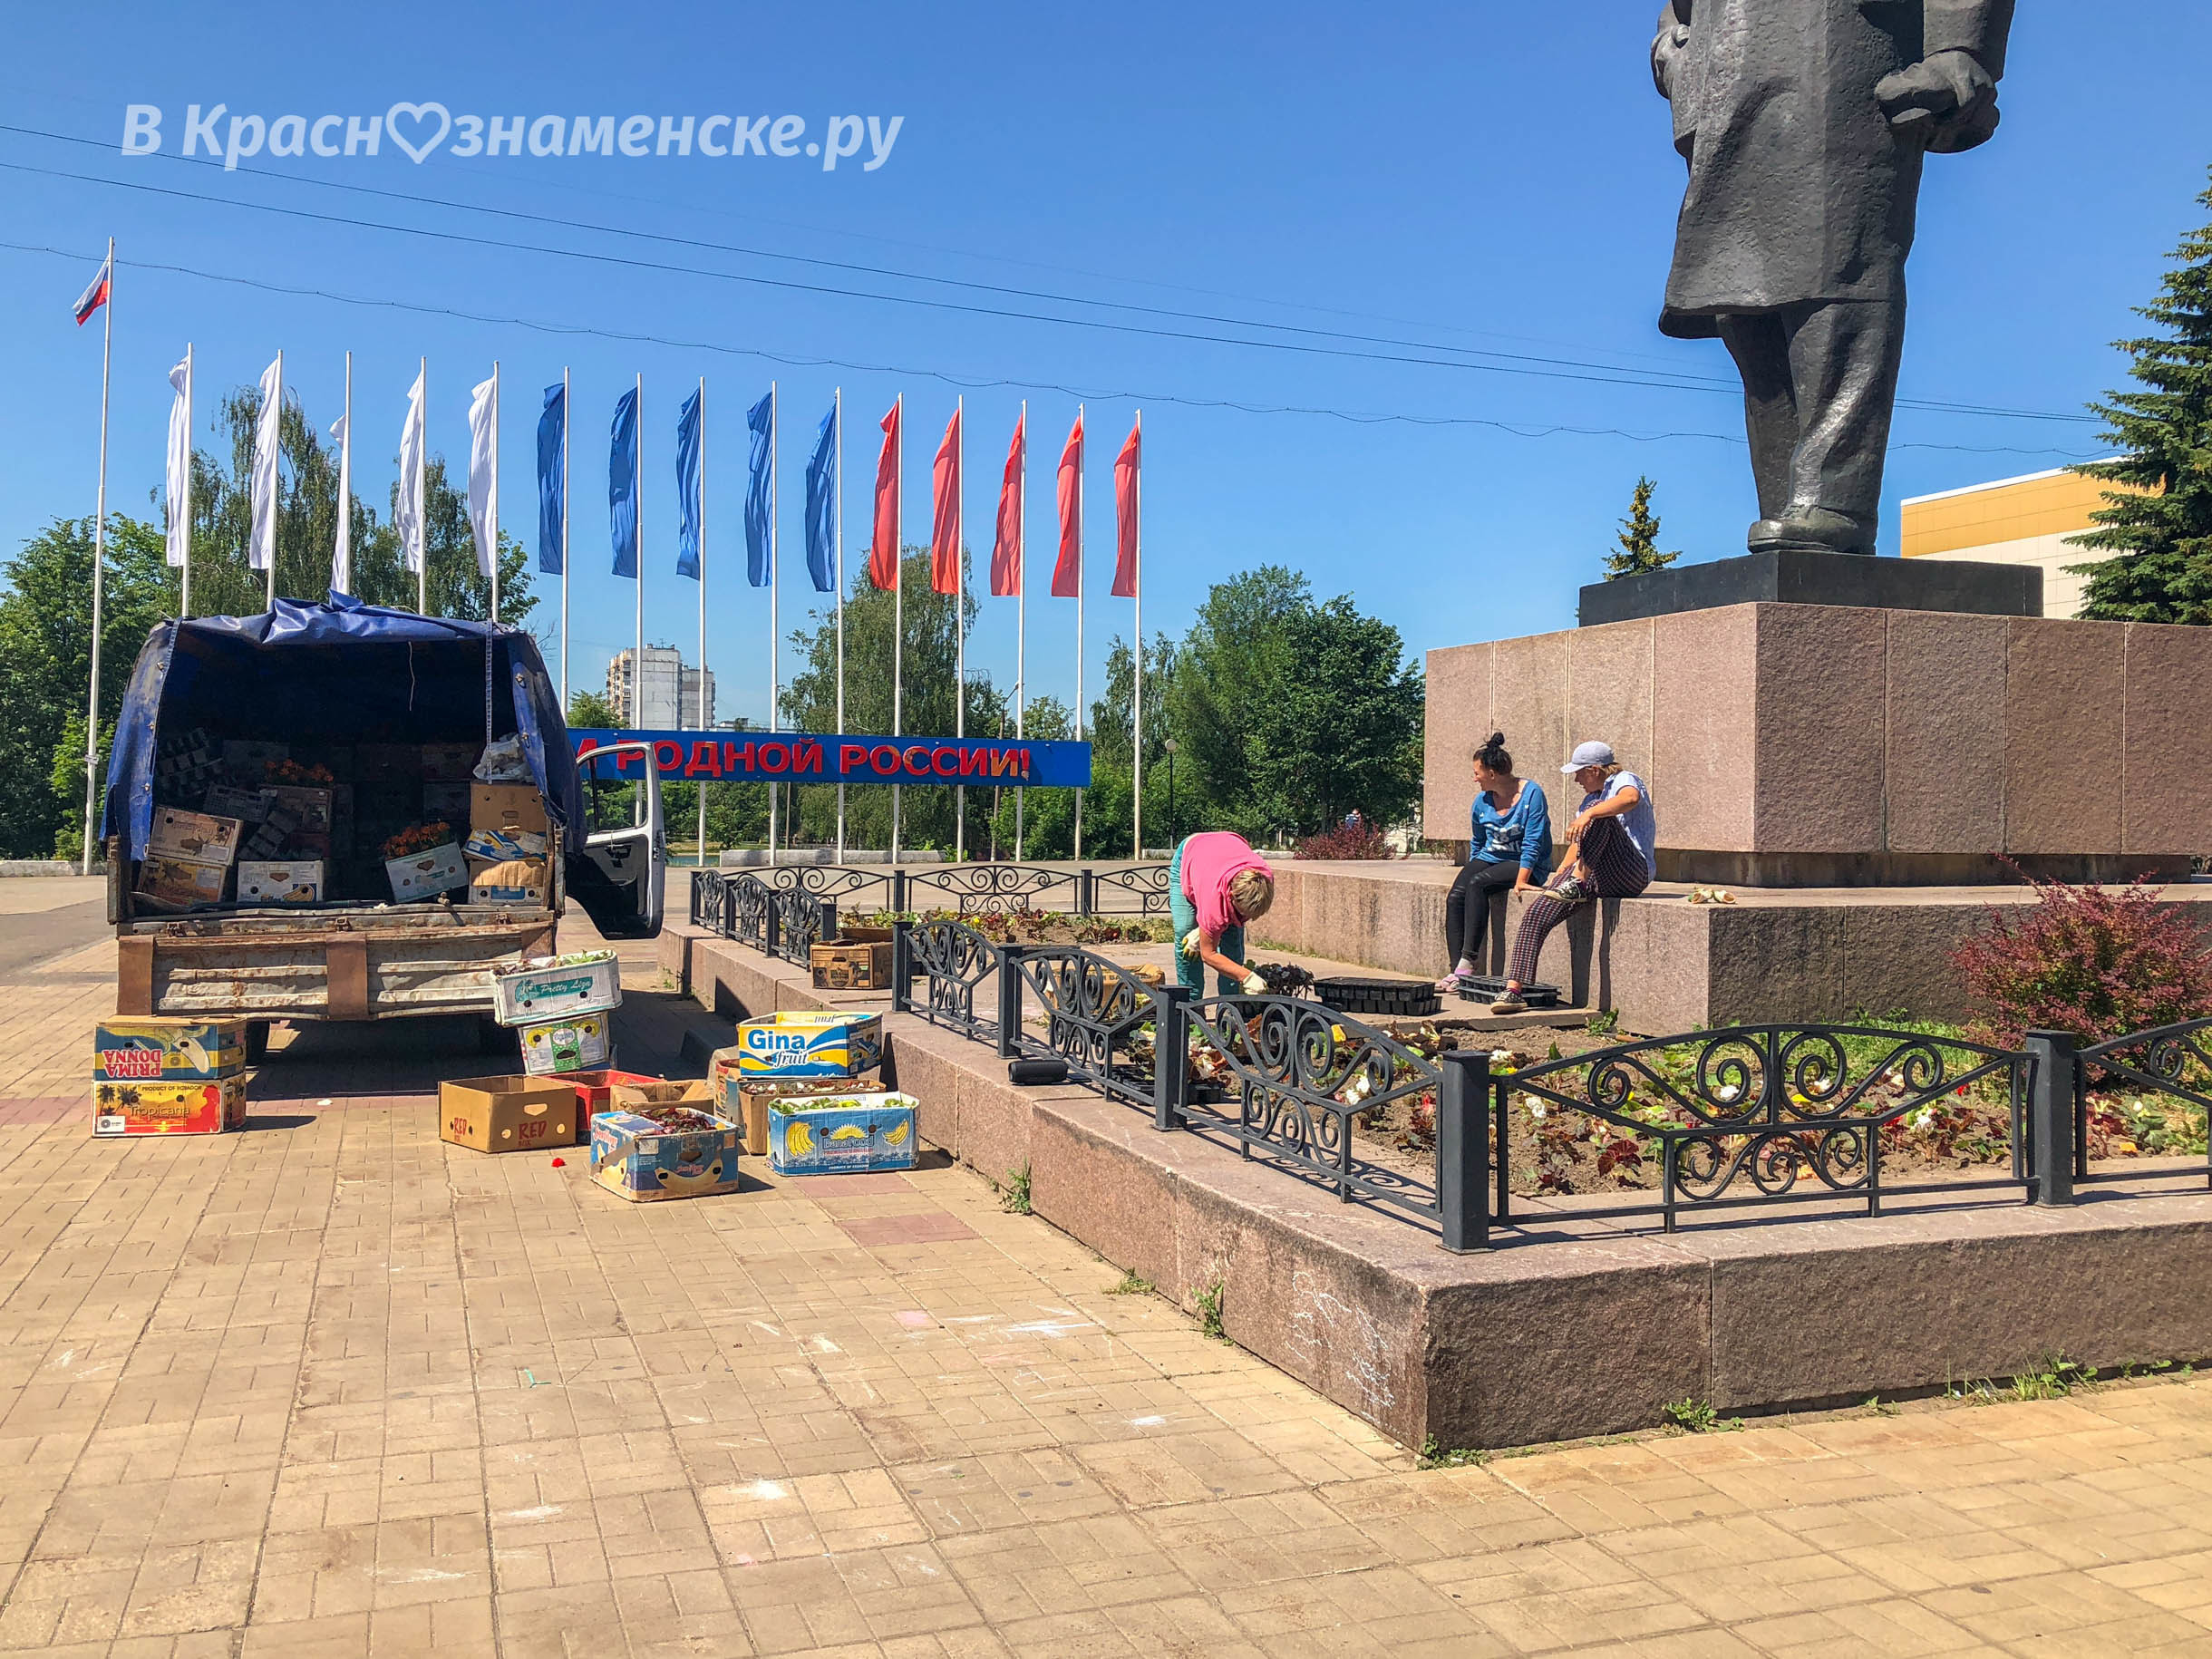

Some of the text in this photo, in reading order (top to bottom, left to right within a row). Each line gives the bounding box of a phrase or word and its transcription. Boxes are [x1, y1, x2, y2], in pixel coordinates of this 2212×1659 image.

[616, 738, 822, 777] РОДНОЙ
[839, 744, 1031, 781] РОССИИ!
[540, 984, 568, 994] Pretty
[748, 1030, 806, 1050] Gina
[102, 1050, 162, 1063] DONNA
[775, 1051, 809, 1067] fruit
[104, 1063, 162, 1077] PRIMA
[454, 1118, 467, 1136] RED
[519, 1121, 547, 1140] RED
